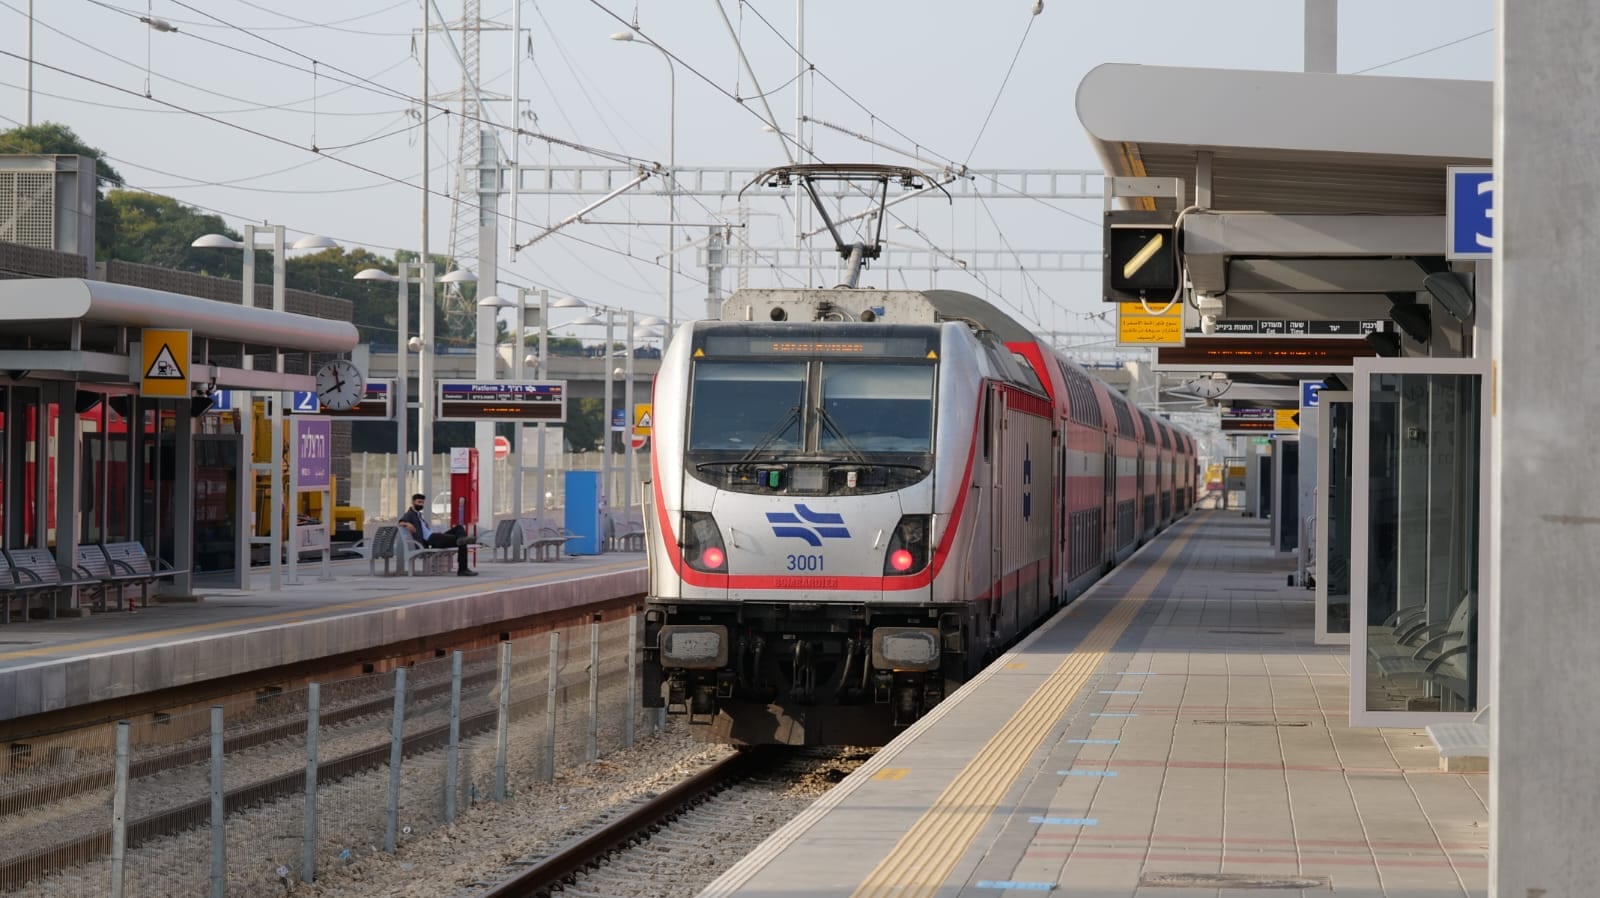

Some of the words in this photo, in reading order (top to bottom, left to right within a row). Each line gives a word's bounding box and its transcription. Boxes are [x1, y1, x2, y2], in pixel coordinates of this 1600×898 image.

[1328, 324, 1341, 332] יעד
[471, 384, 498, 392] Platform
[499, 384, 505, 392] 2
[298, 391, 313, 410] 2
[786, 554, 824, 571] 3001
